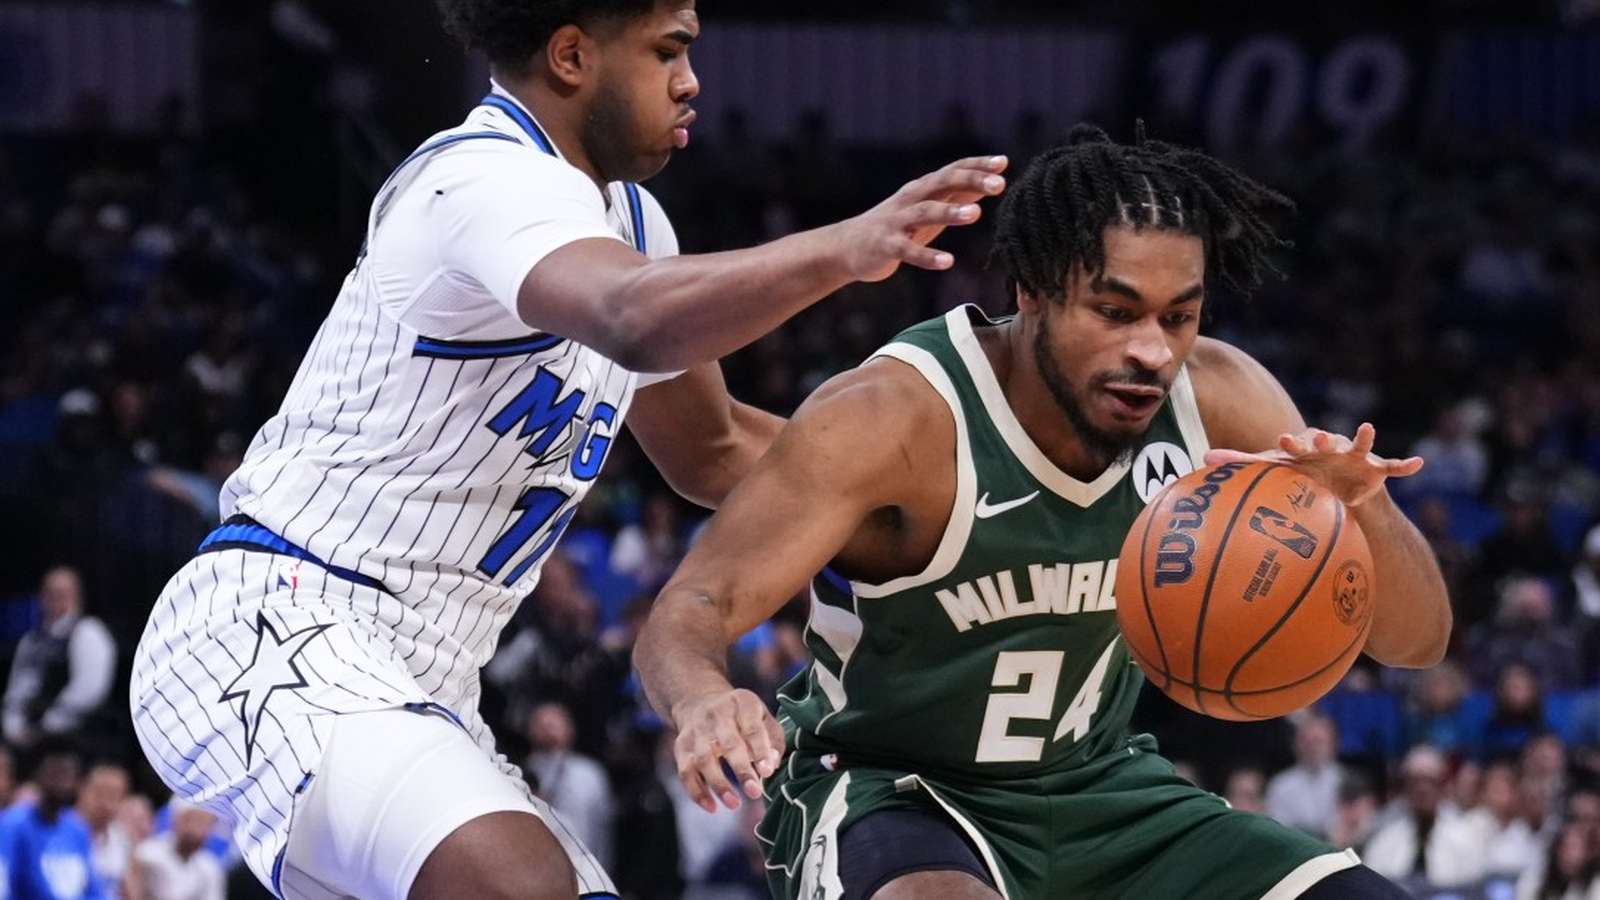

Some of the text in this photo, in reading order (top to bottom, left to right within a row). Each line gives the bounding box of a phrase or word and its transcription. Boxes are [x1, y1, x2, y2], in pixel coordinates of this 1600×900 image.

[1153, 35, 1408, 154] 109
[1153, 461, 1253, 588] Wilson
[975, 634, 1122, 763] 24
